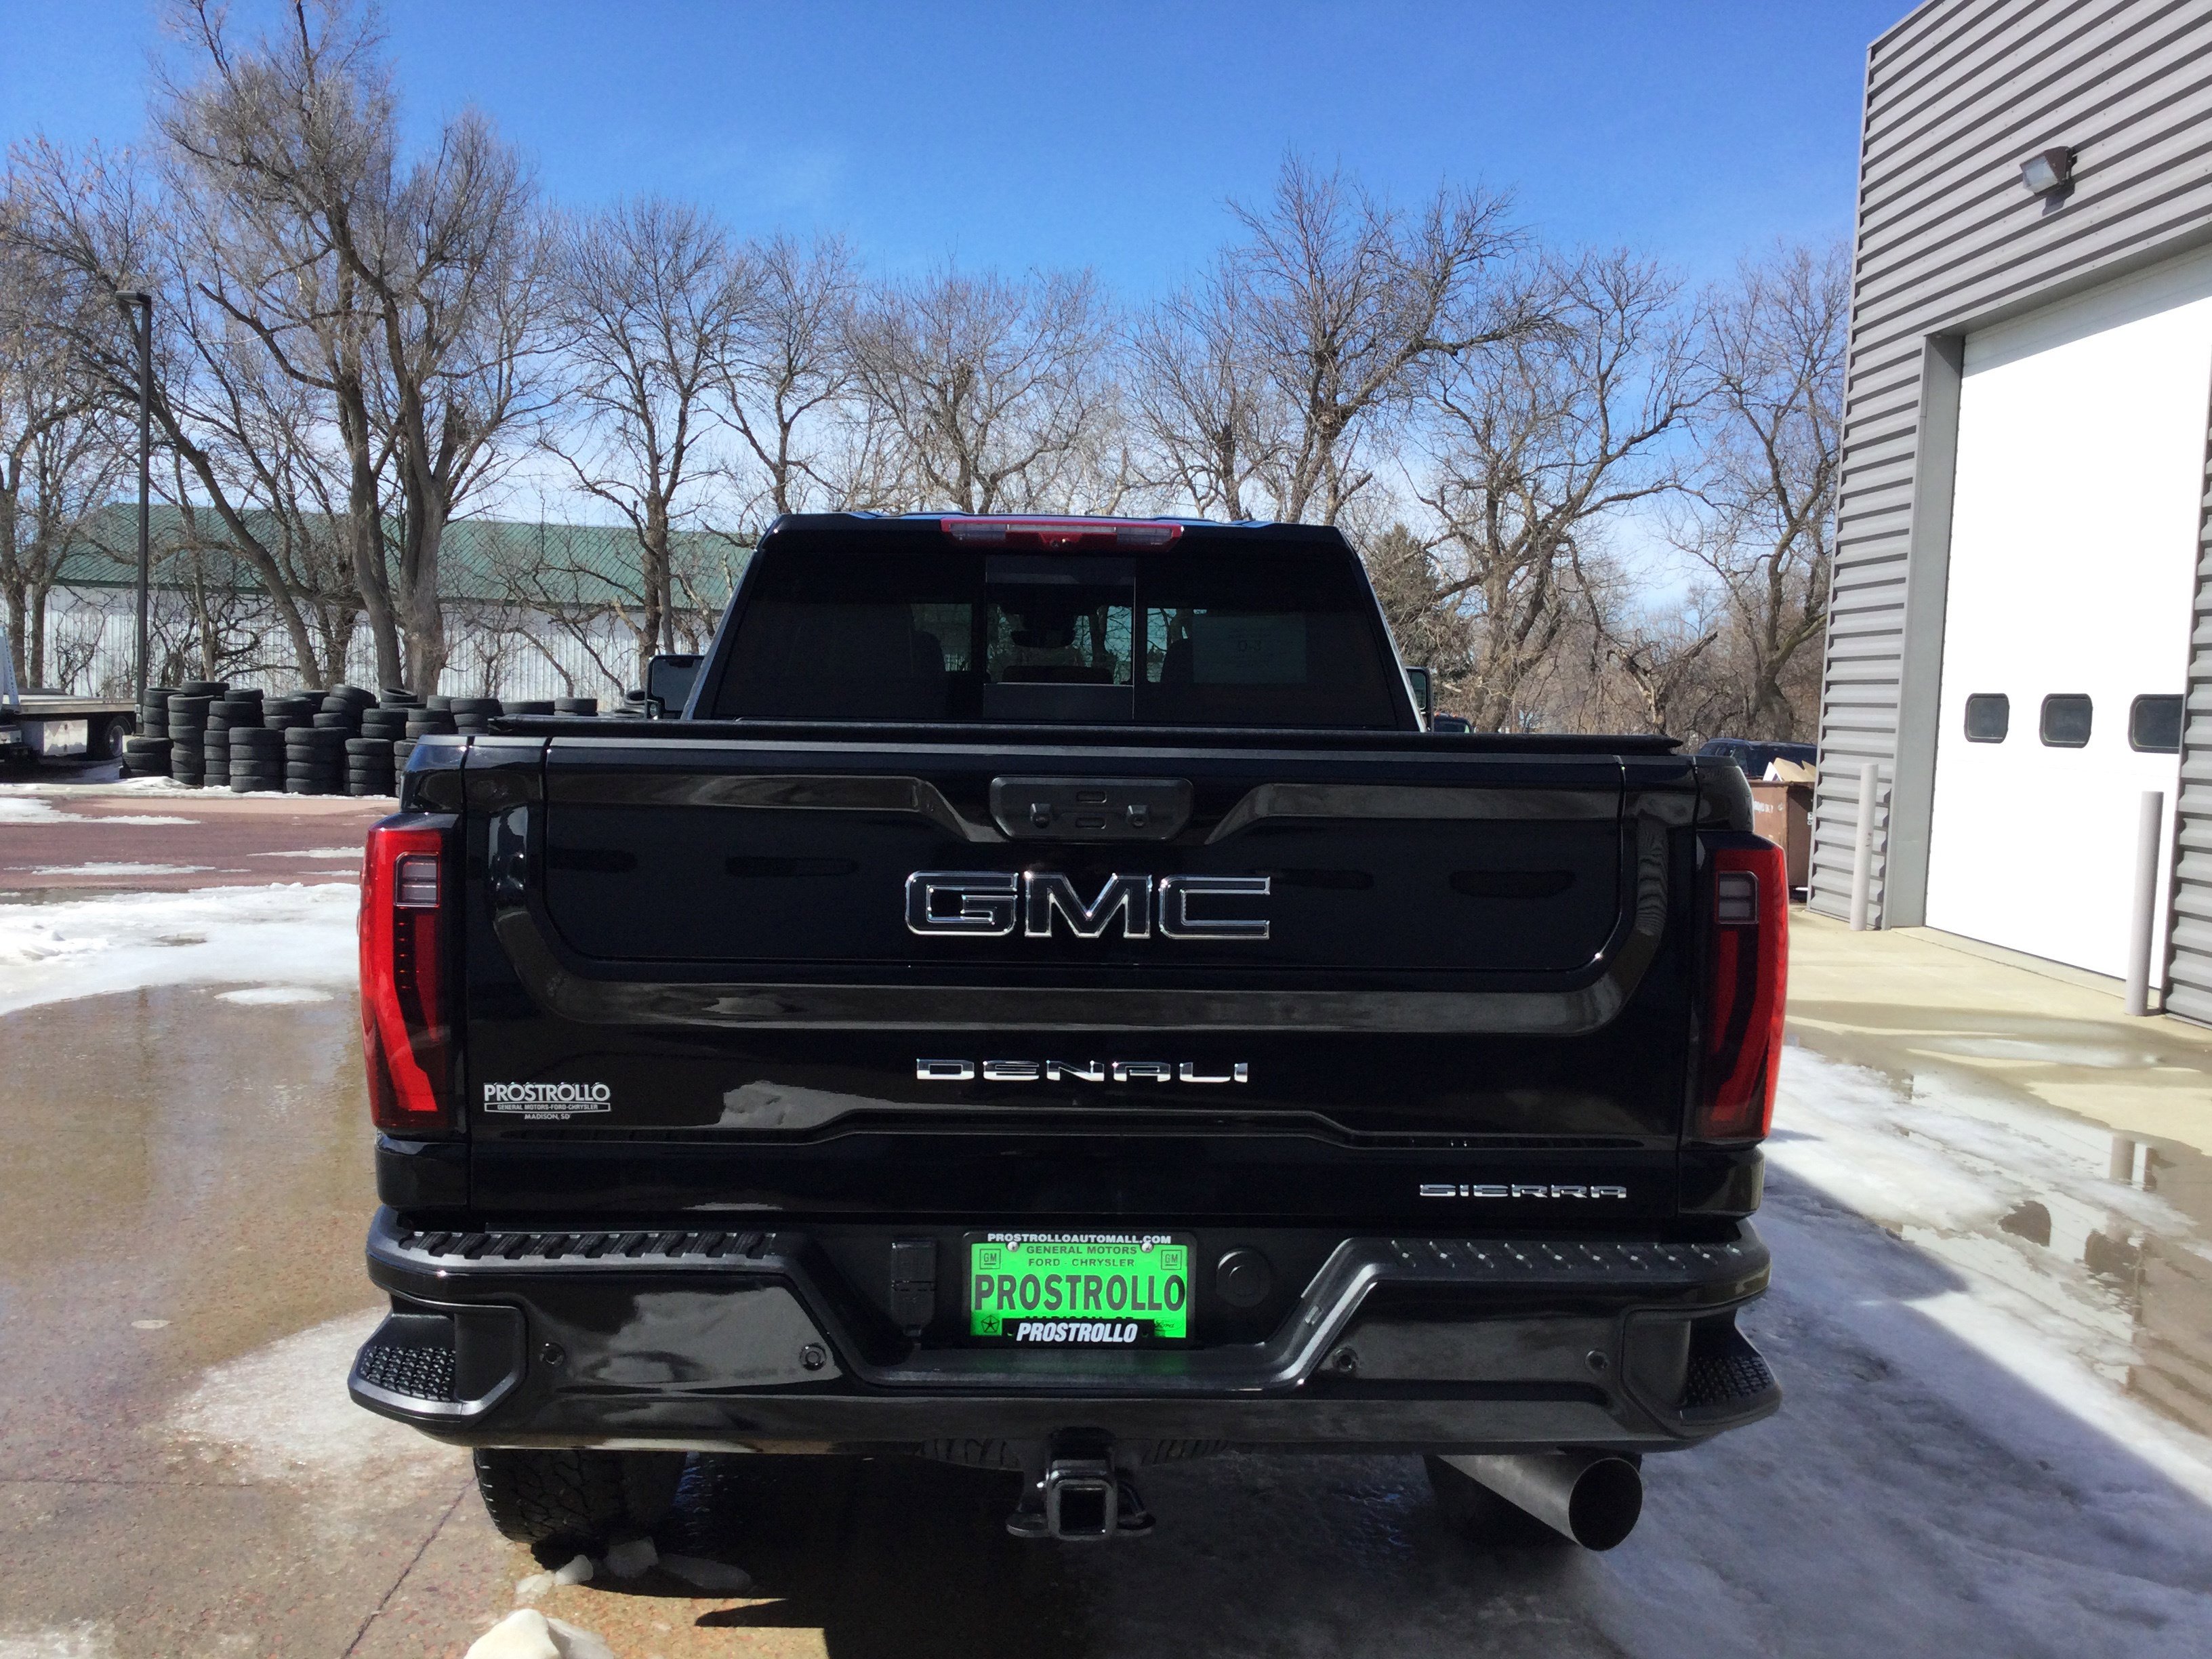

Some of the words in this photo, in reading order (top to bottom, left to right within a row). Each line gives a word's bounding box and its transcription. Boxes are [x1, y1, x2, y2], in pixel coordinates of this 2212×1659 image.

[905, 870, 1271, 939] GMC
[916, 1059, 1248, 1083] DENALI
[484, 1084, 611, 1102] PROSTROLLO
[1420, 1184, 1627, 1199] SIERRA
[987, 1233, 1171, 1244] PROSTROLLOAUTOMALL.COM
[983, 1253, 997, 1263] GM
[1026, 1246, 1083, 1254] GENERAL
[1086, 1246, 1137, 1255] MOTORS
[1028, 1258, 1061, 1267] FORD
[1071, 1259, 1135, 1267] CHRYSLER
[1165, 1254, 1178, 1263] GM
[975, 1273, 1185, 1311] PROSTROLLO
[1017, 1322, 1138, 1343] PROSTROLLO
